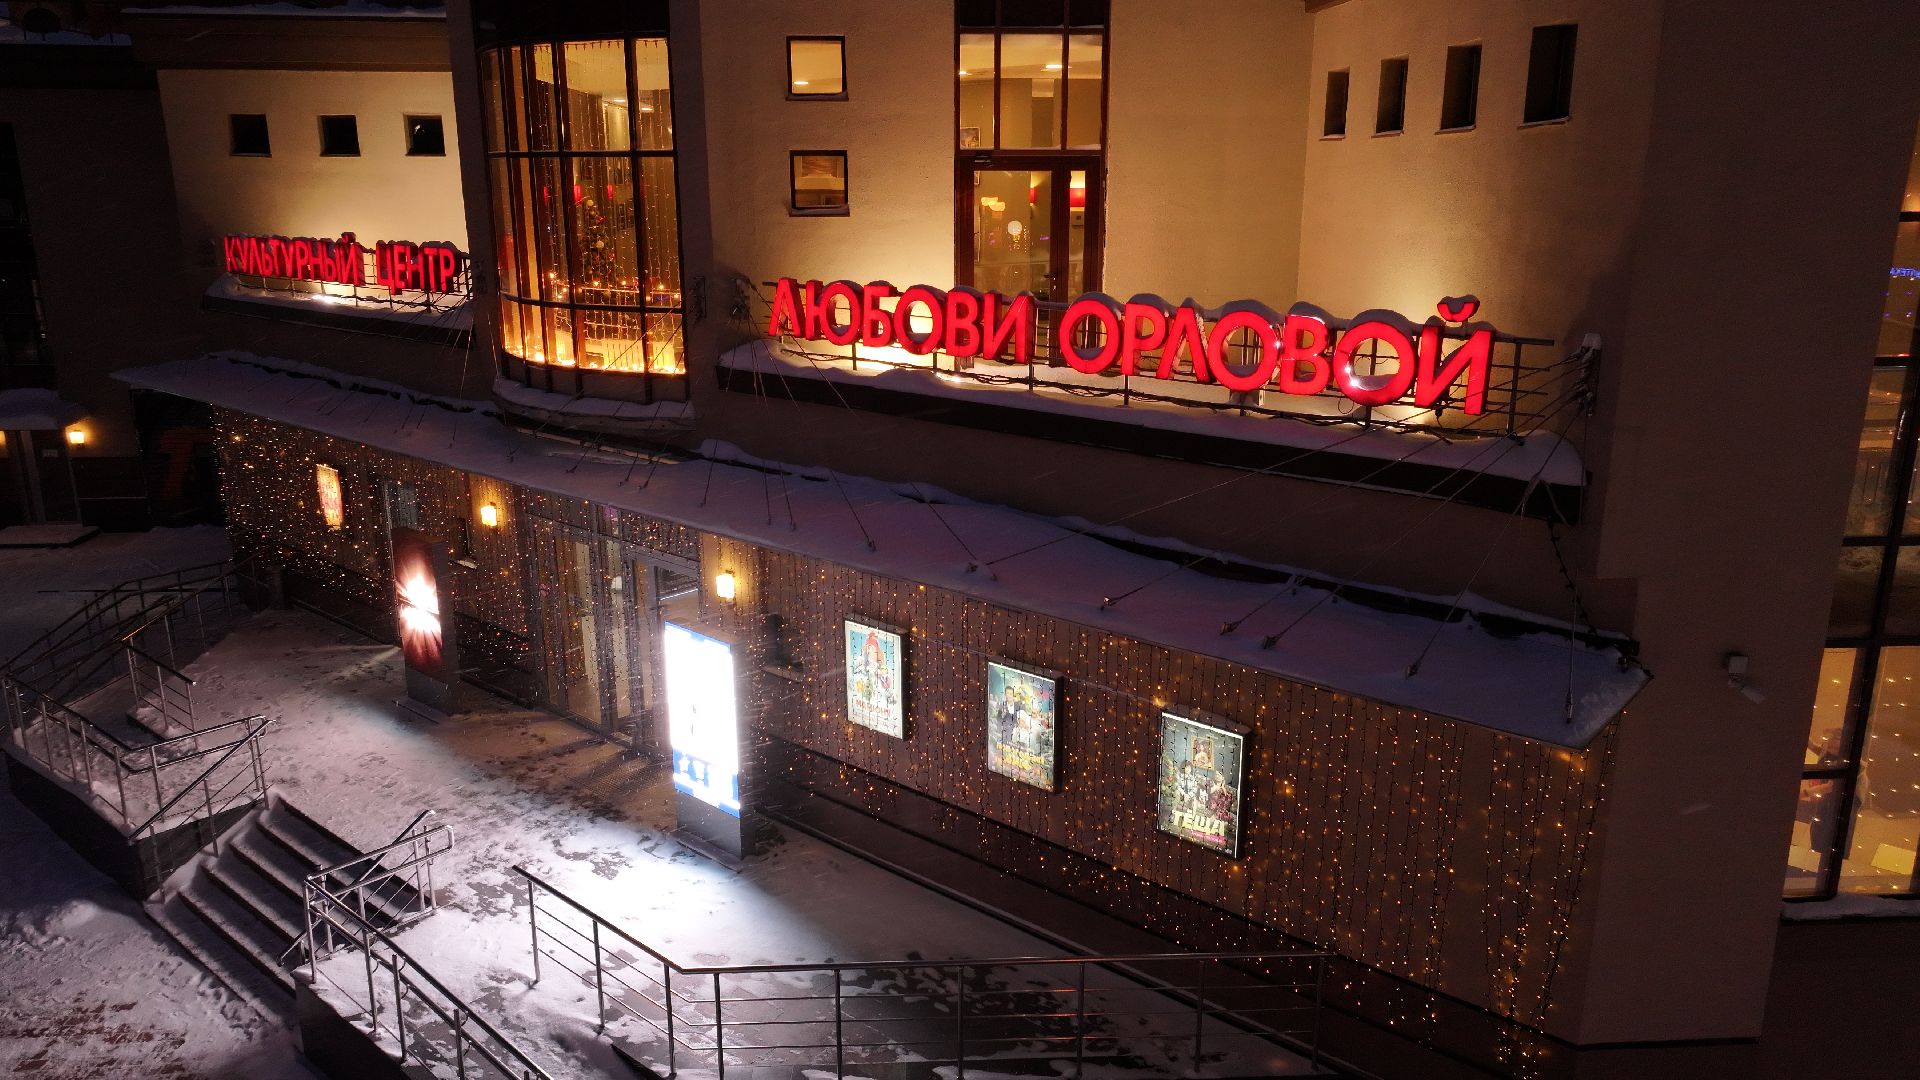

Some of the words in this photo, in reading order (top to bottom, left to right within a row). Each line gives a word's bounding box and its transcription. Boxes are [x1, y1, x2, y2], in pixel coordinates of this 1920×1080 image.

[224, 233, 365, 287] КУЛЬТУРНЫЙ
[375, 241, 459, 295] ЦЕНТР
[768, 278, 1036, 364] ЛЮБОВИ
[1059, 299, 1495, 415] ОРЛОВОЙ
